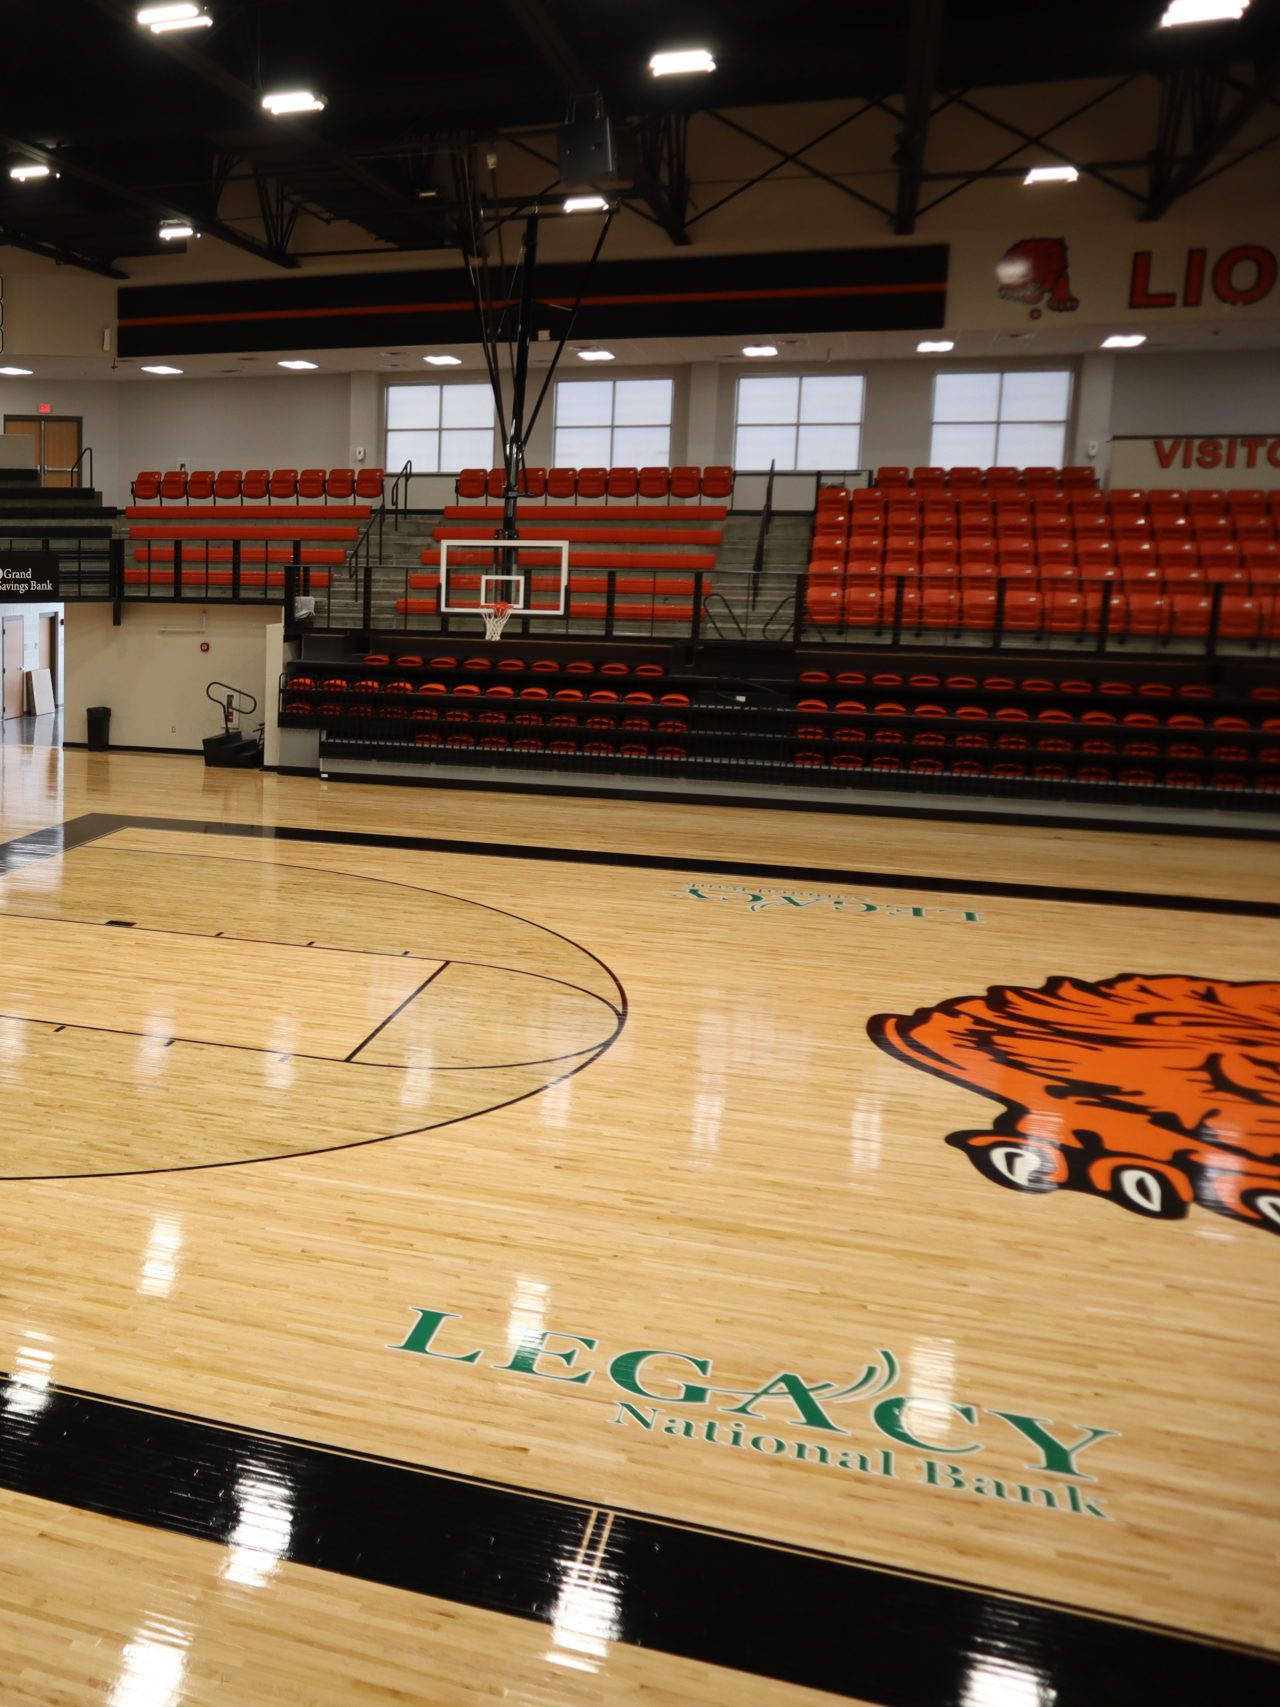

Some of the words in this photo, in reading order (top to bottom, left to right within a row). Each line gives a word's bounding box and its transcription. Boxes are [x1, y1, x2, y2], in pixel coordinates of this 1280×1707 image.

[1129, 244, 1279, 309] LIO
[3, 568, 32, 579] Grand
[30, 581, 53, 591] Bank
[385, 1305, 1122, 1483] LEGACY
[609, 1400, 897, 1480] National
[919, 1458, 1114, 1521] Bank
